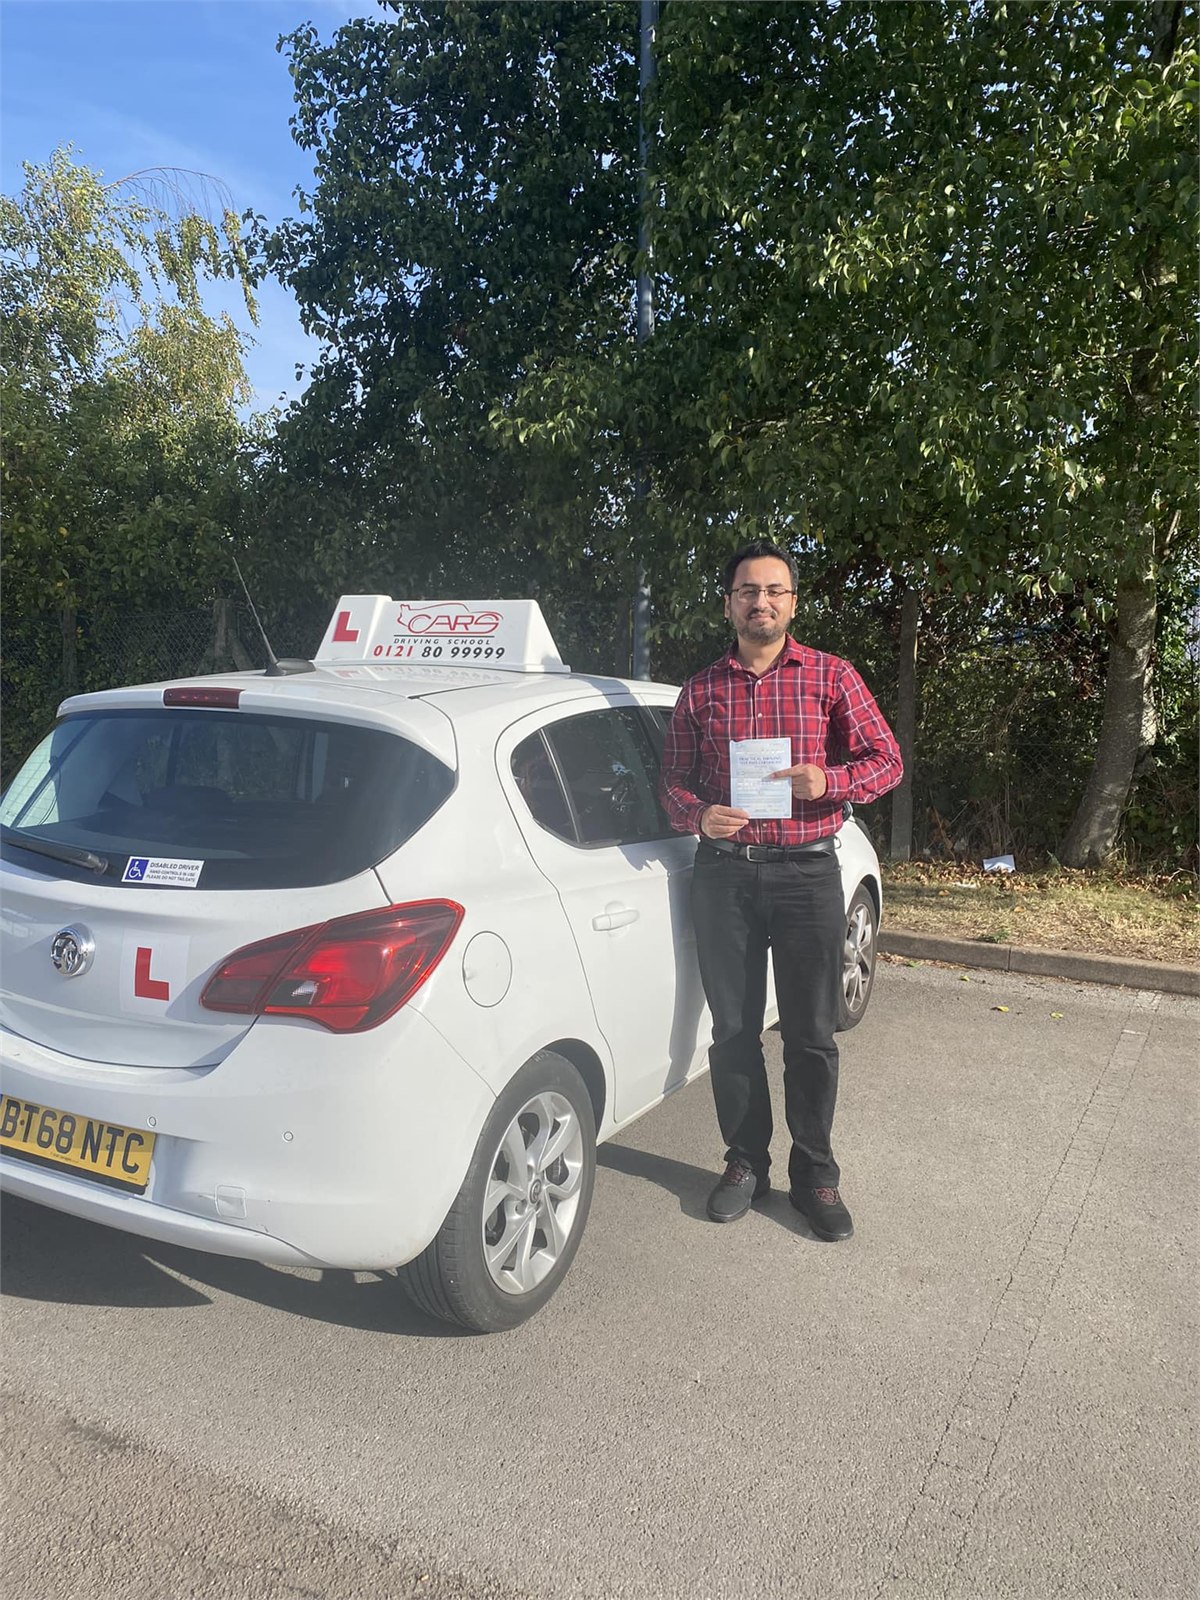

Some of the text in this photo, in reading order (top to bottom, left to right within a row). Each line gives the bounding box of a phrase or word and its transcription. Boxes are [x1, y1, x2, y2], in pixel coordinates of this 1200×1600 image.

[332, 611, 360, 643] L
[407, 612, 500, 635] CARS
[373, 645, 505, 659] 0121 80 99999
[447, 638, 491, 646] SCHOOL
[134, 947, 169, 1001] L
[0, 1099, 144, 1174] BT68 NTC
